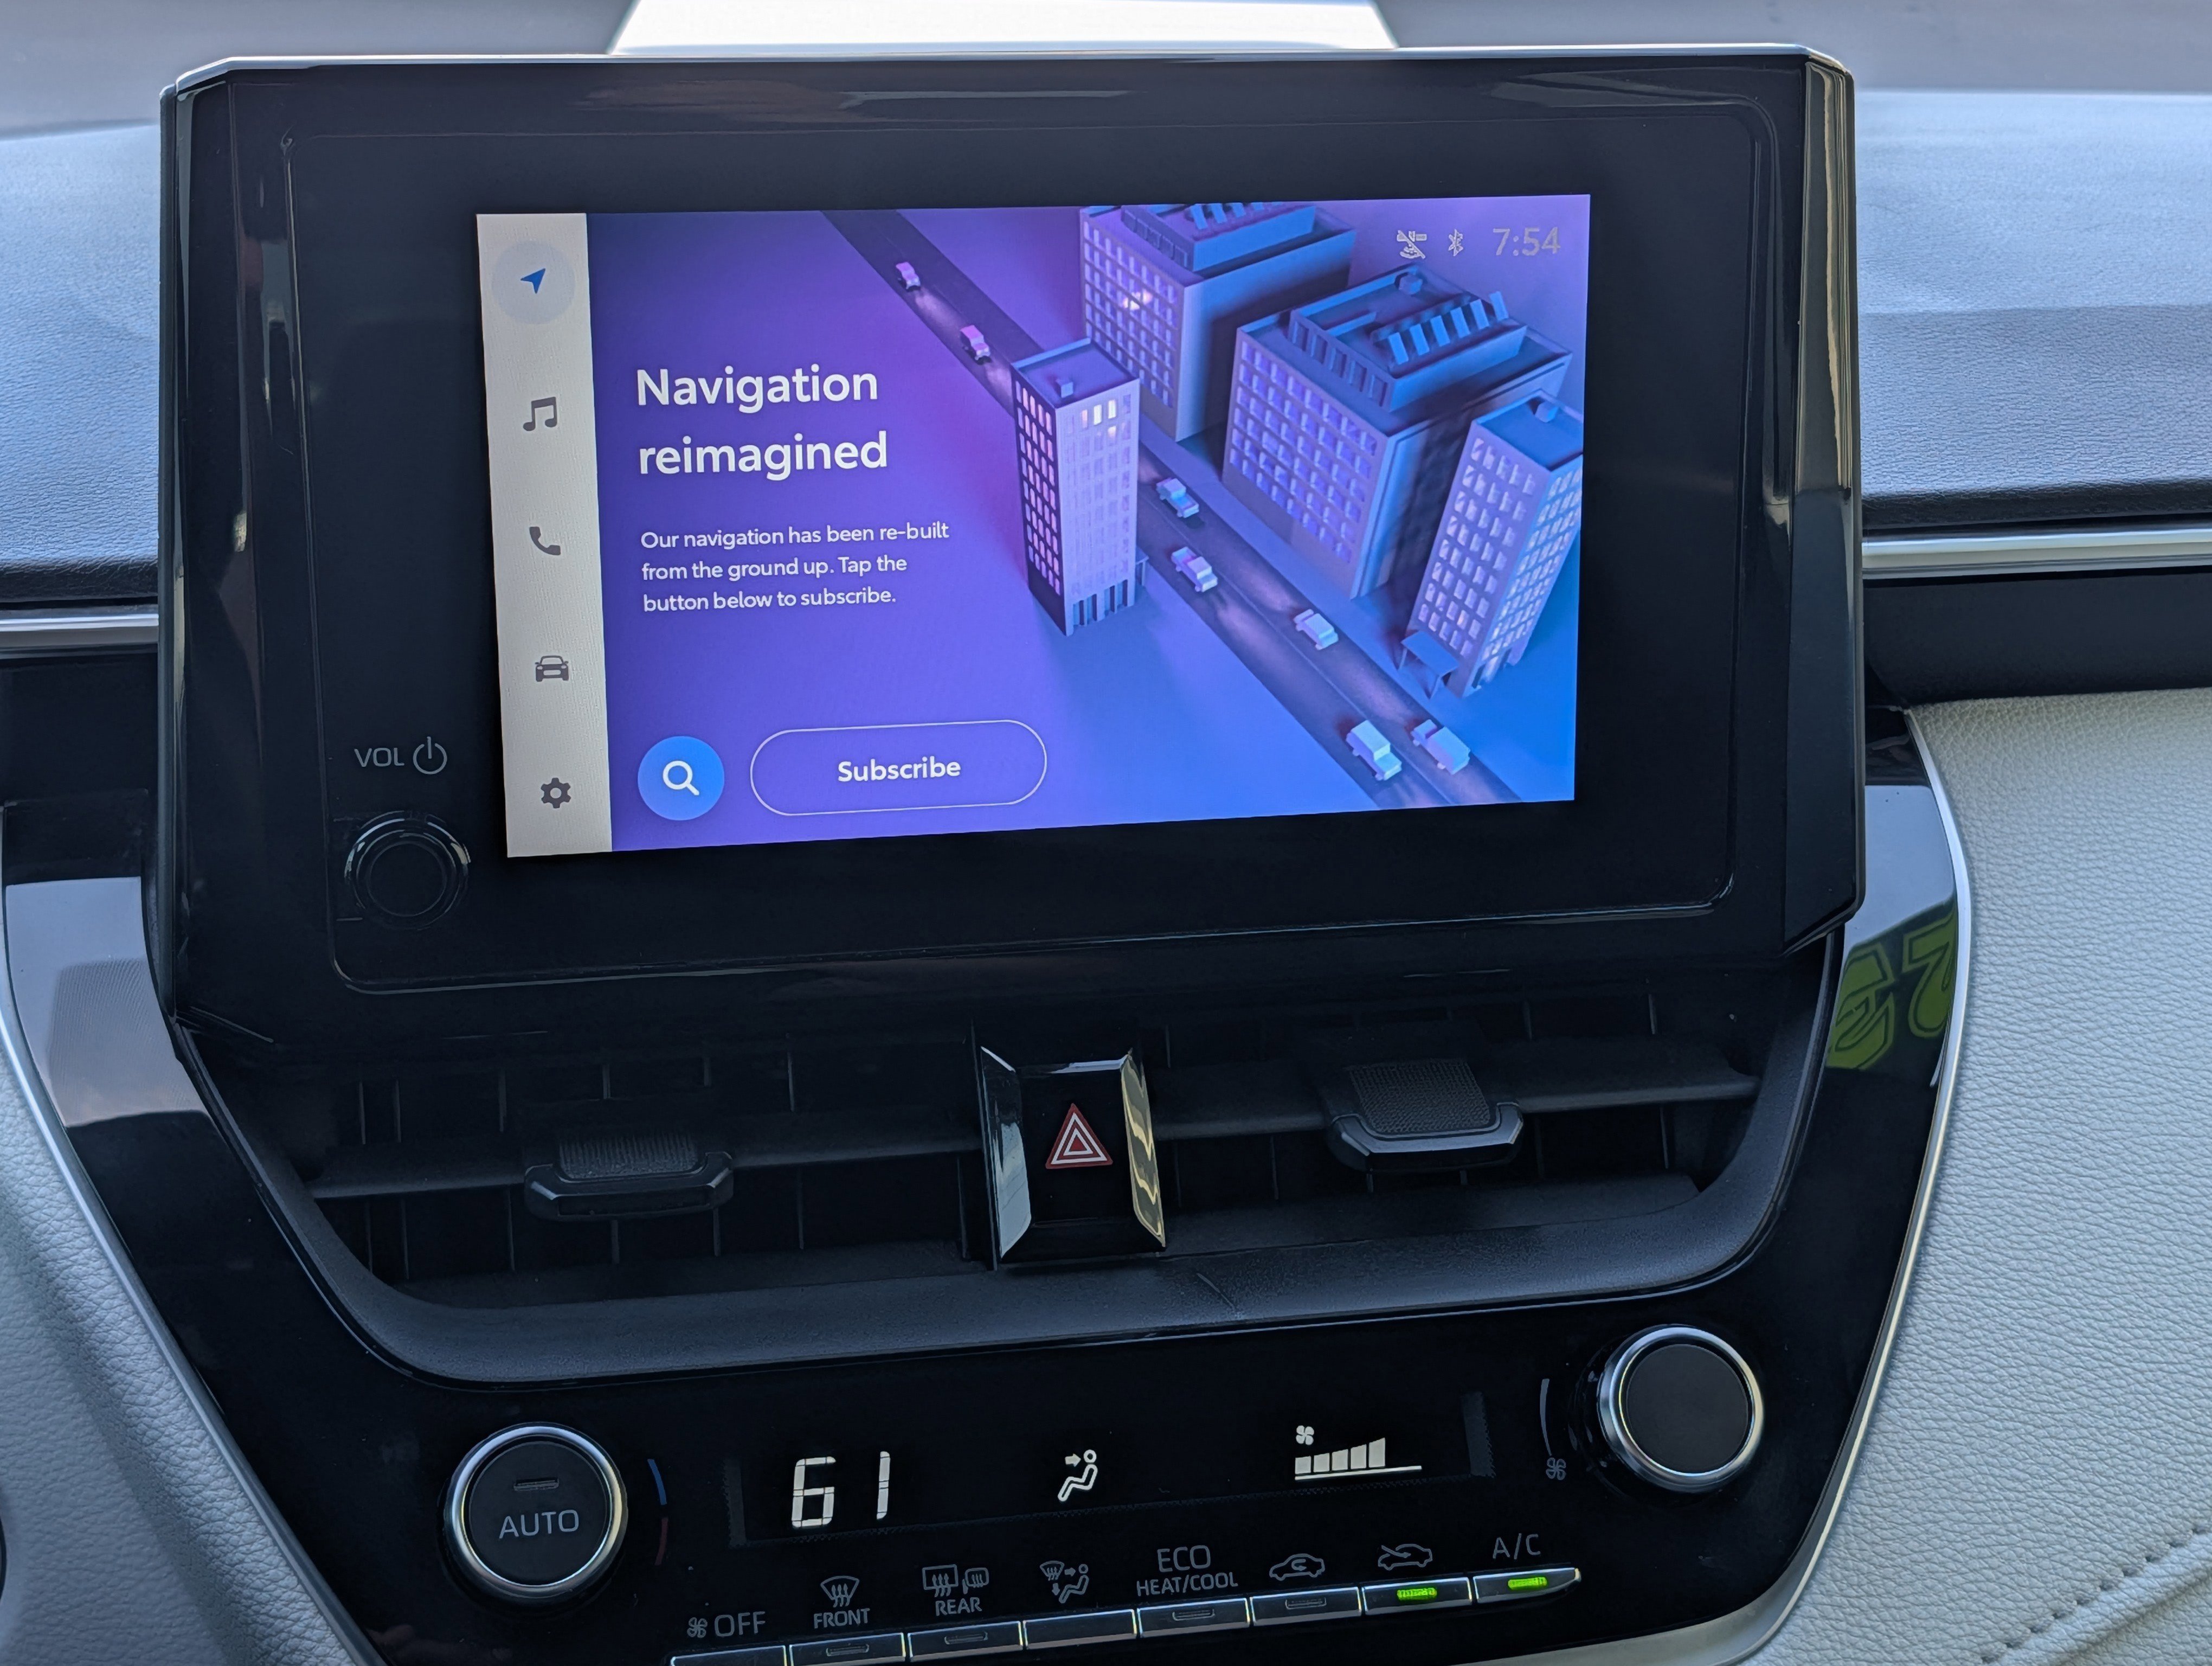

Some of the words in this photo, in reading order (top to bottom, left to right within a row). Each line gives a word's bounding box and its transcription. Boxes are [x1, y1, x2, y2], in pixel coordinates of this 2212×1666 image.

[1493, 227, 1561, 256] 7:54
[637, 363, 878, 414] Navigation
[640, 430, 887, 481] reimagined
[641, 531, 679, 548] Our
[684, 528, 784, 550] navigation
[788, 526, 821, 543] has
[827, 525, 874, 542] been
[880, 521, 950, 540] re-built
[641, 562, 687, 580] from
[691, 561, 723, 578] the
[728, 557, 799, 581] ground
[803, 562, 834, 578] up.
[837, 556, 872, 577] Tap
[876, 554, 908, 572] the
[644, 594, 709, 612] button
[713, 591, 773, 609] below
[776, 591, 797, 606] to
[800, 586, 896, 606] subscribe.
[354, 747, 405, 767] VOL
[838, 755, 961, 782] Subscribe
[791, 1451, 891, 1528] 61
[499, 1509, 579, 1539] AUTO
[1157, 1545, 1211, 1572] ECO
[1492, 1533, 1541, 1560] A/C
[1136, 1572, 1238, 1597] HEAT/COOL
[813, 1607, 871, 1629] FRONT
[935, 1597, 982, 1617] REAR
[714, 1611, 766, 1637] OFF
